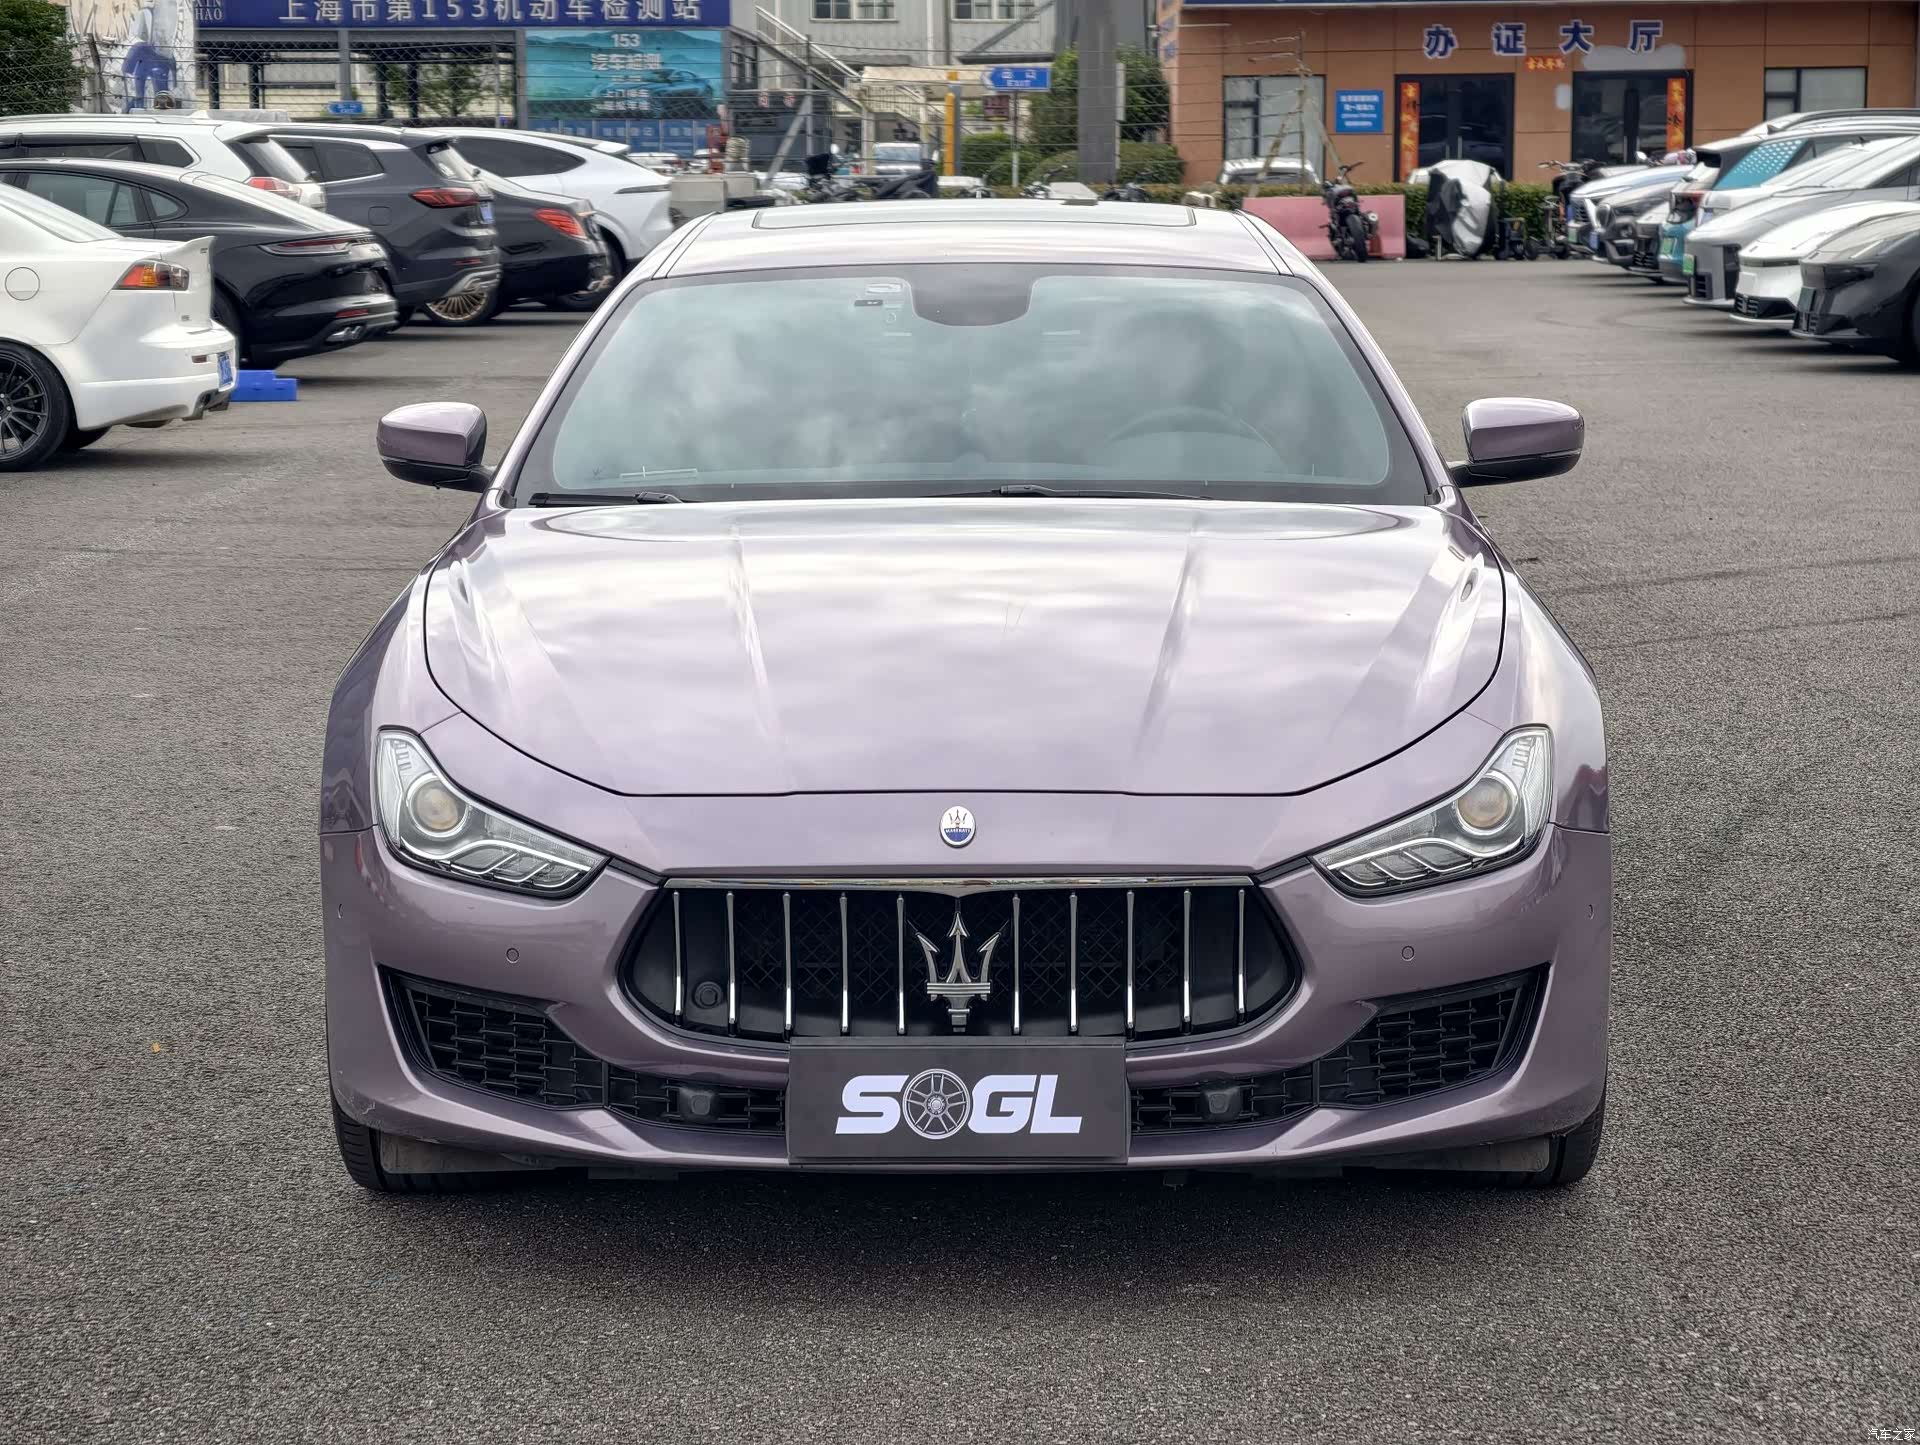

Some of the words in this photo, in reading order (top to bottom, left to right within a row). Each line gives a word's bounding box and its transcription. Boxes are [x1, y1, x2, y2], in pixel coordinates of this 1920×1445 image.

[195, 8, 222, 20] HAO
[611, 33, 641, 47] 153
[1424, 19, 1663, 59] 办证大厅
